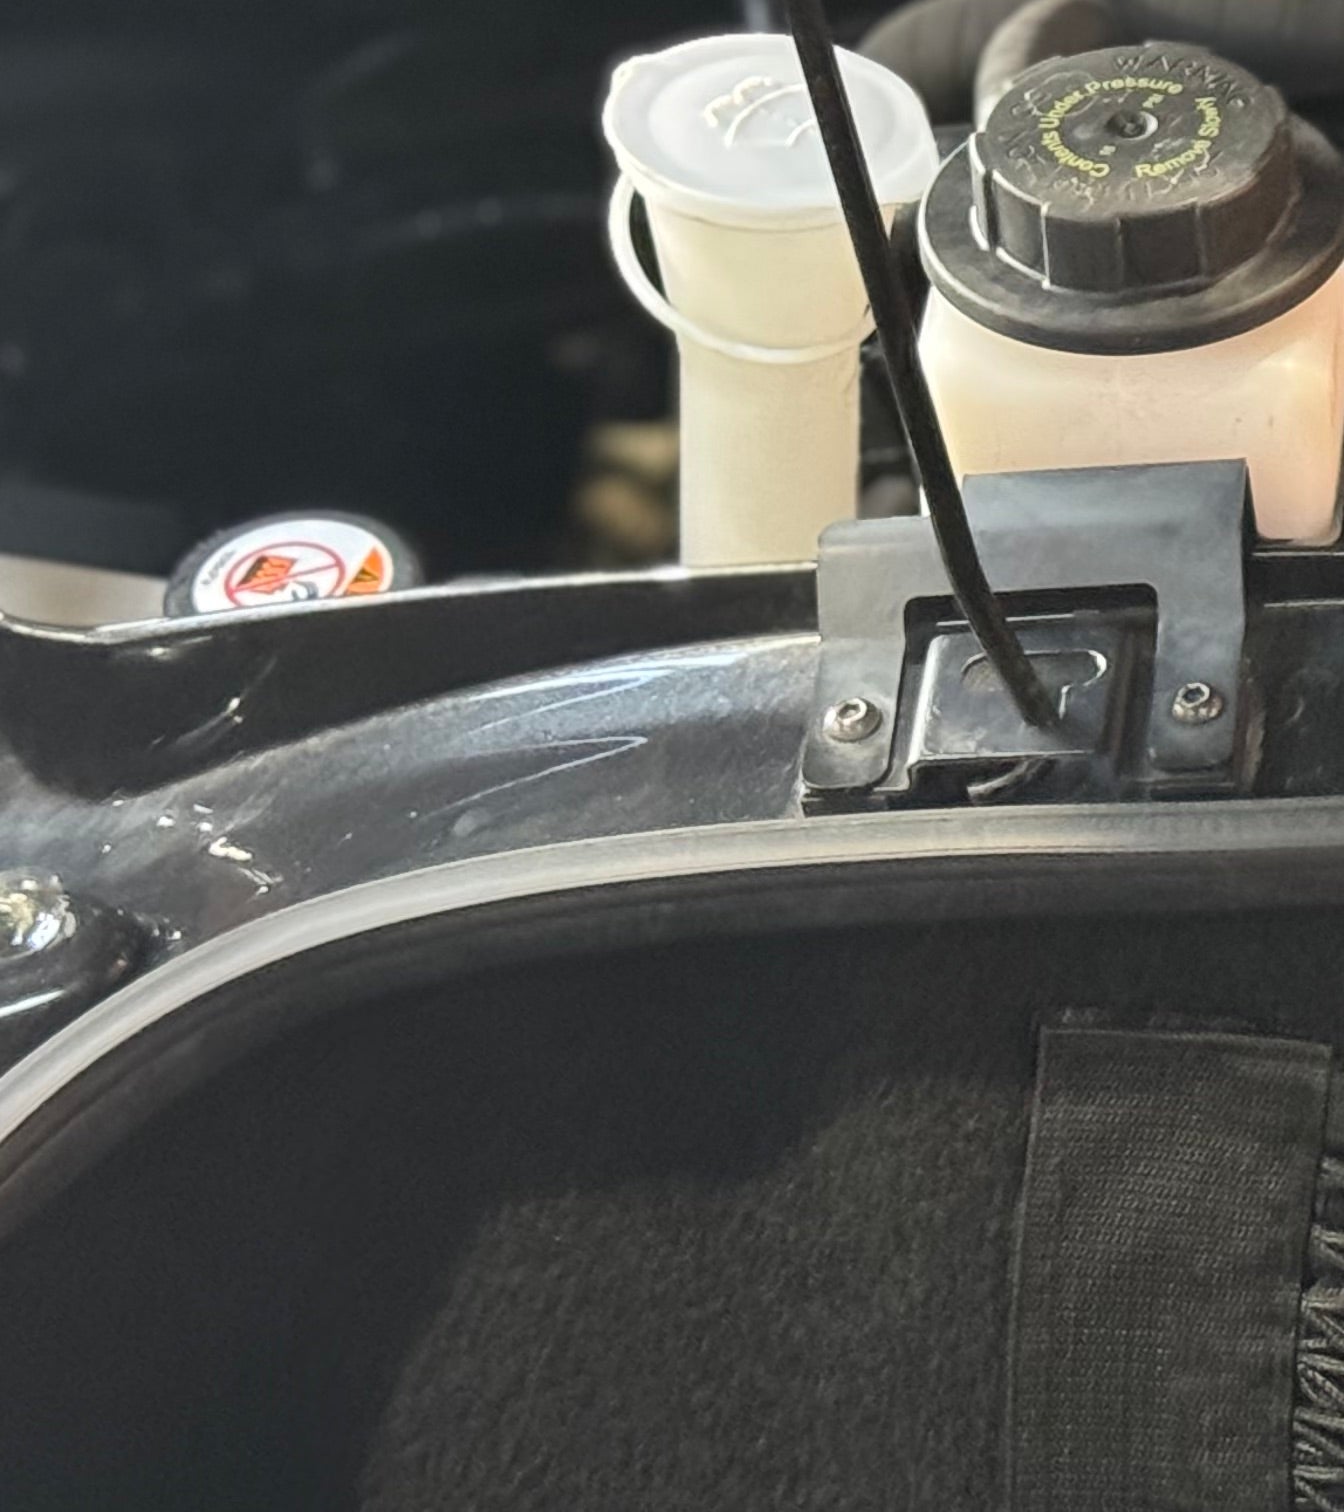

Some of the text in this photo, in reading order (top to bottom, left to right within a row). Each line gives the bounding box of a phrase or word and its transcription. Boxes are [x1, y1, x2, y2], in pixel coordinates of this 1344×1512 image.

[1038, 76, 1184, 178] Contents Under Pressure
[1135, 139, 1212, 178] Remove
